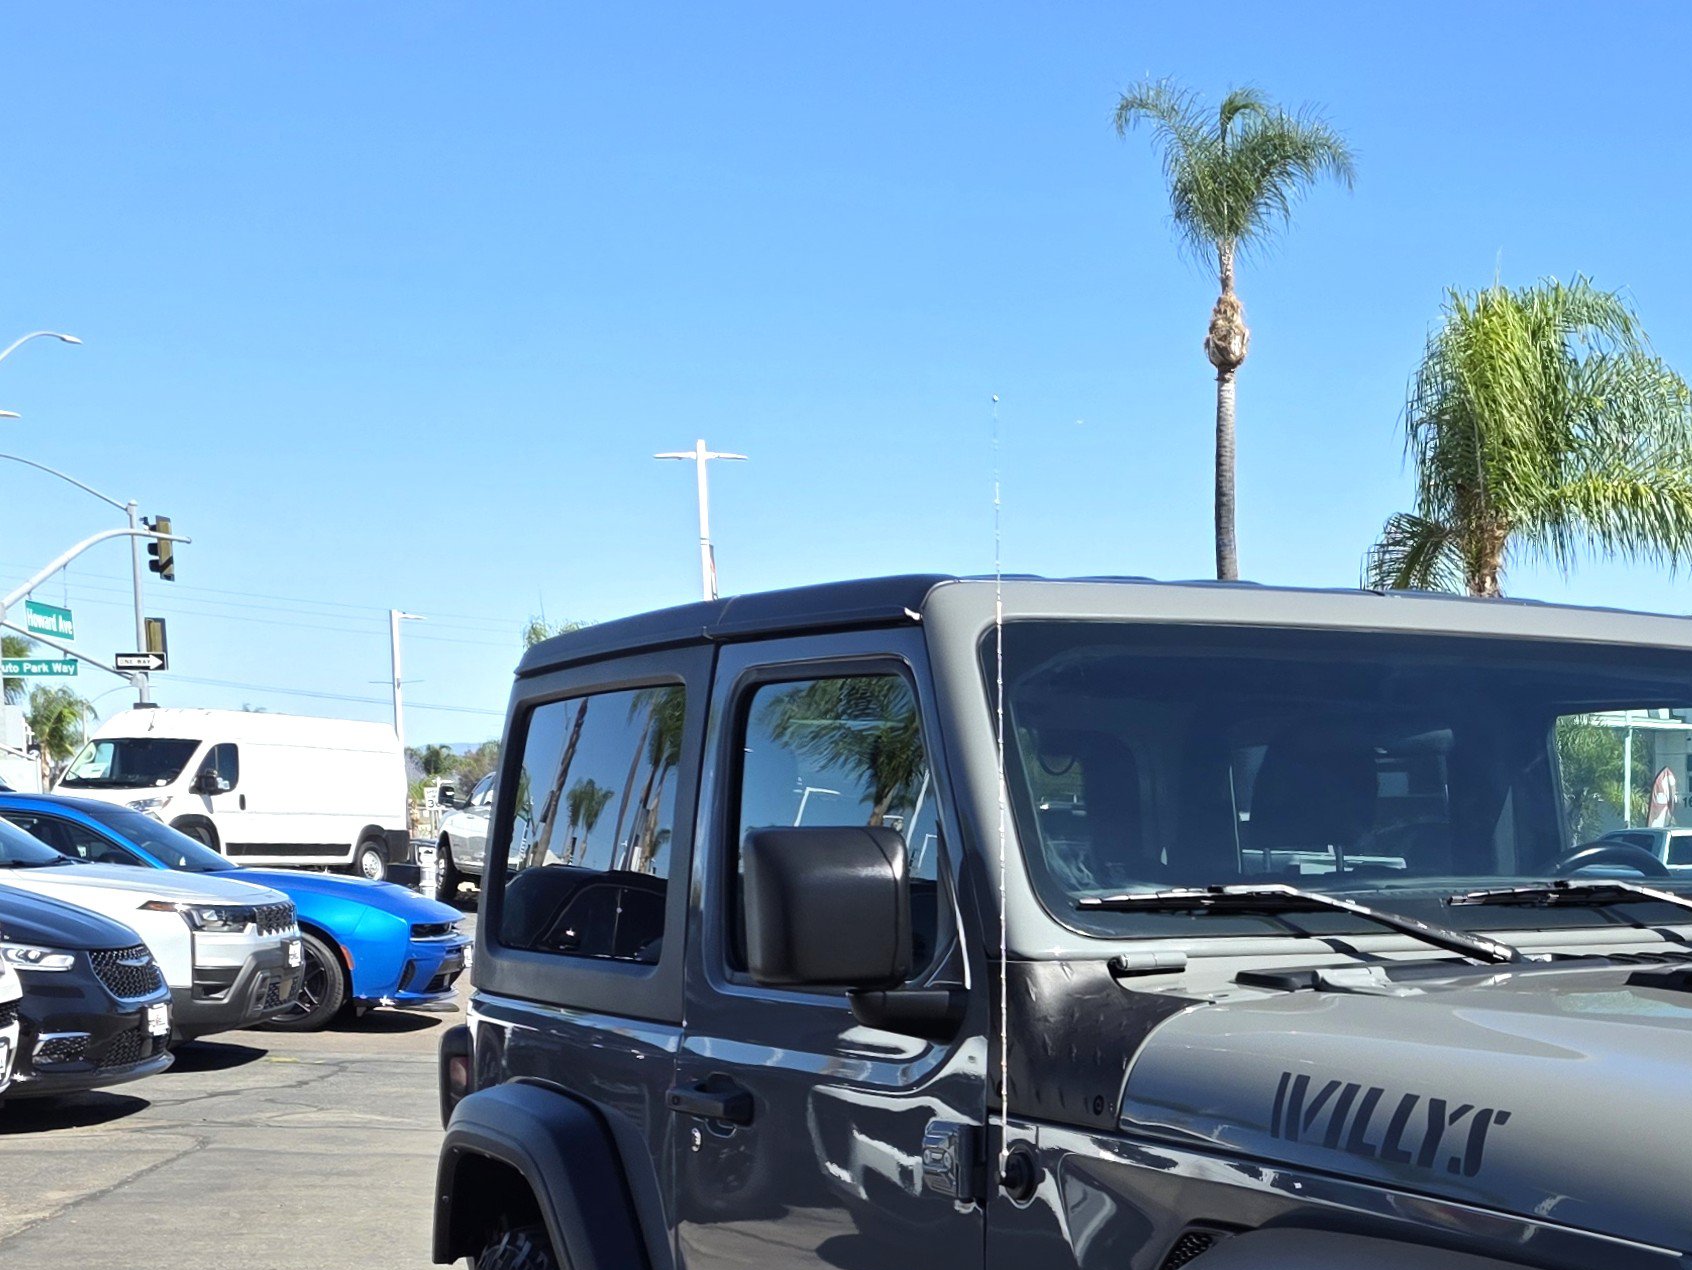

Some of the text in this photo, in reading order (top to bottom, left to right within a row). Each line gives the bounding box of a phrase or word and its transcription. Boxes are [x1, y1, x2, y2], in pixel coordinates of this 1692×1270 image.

[27, 607, 73, 635] Howard Ave
[0, 662, 75, 675] uto Park Way
[1270, 1071, 1512, 1178] WILLYS
